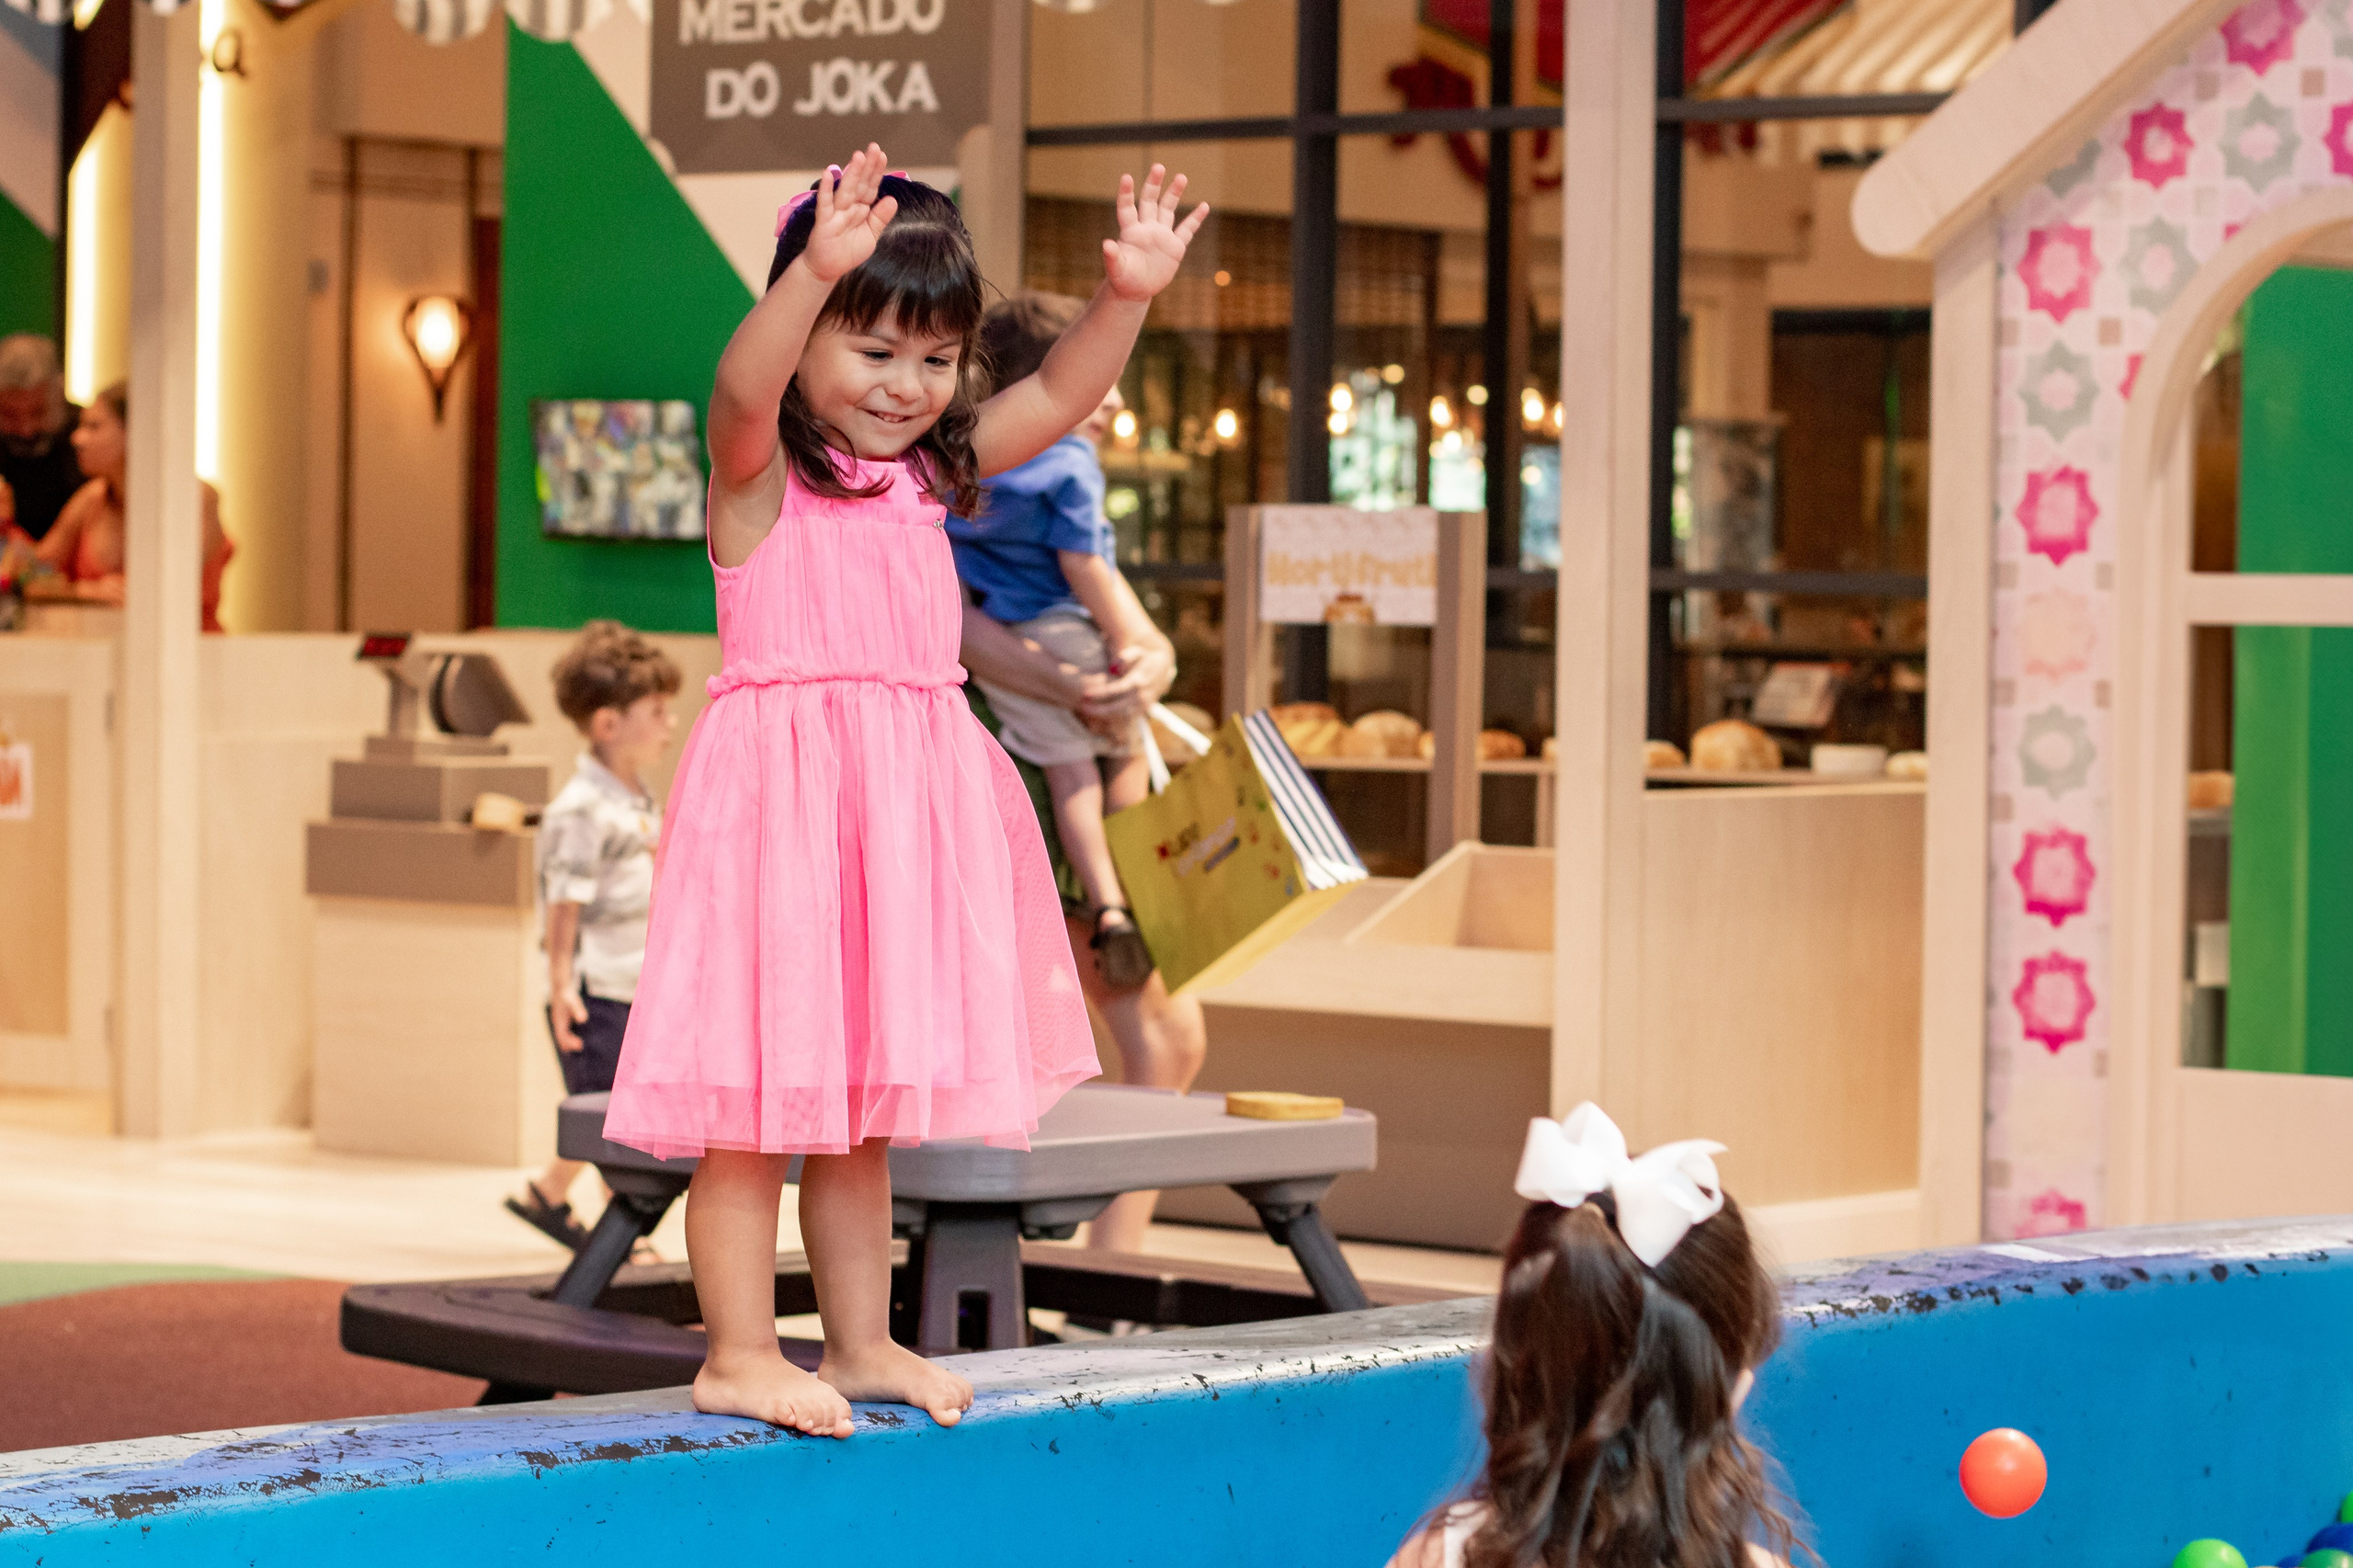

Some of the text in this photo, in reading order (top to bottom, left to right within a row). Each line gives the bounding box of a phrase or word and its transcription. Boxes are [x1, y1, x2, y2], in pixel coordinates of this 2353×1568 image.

[679, 0, 945, 44] MERCADO
[705, 58, 940, 119] DO JOKA
